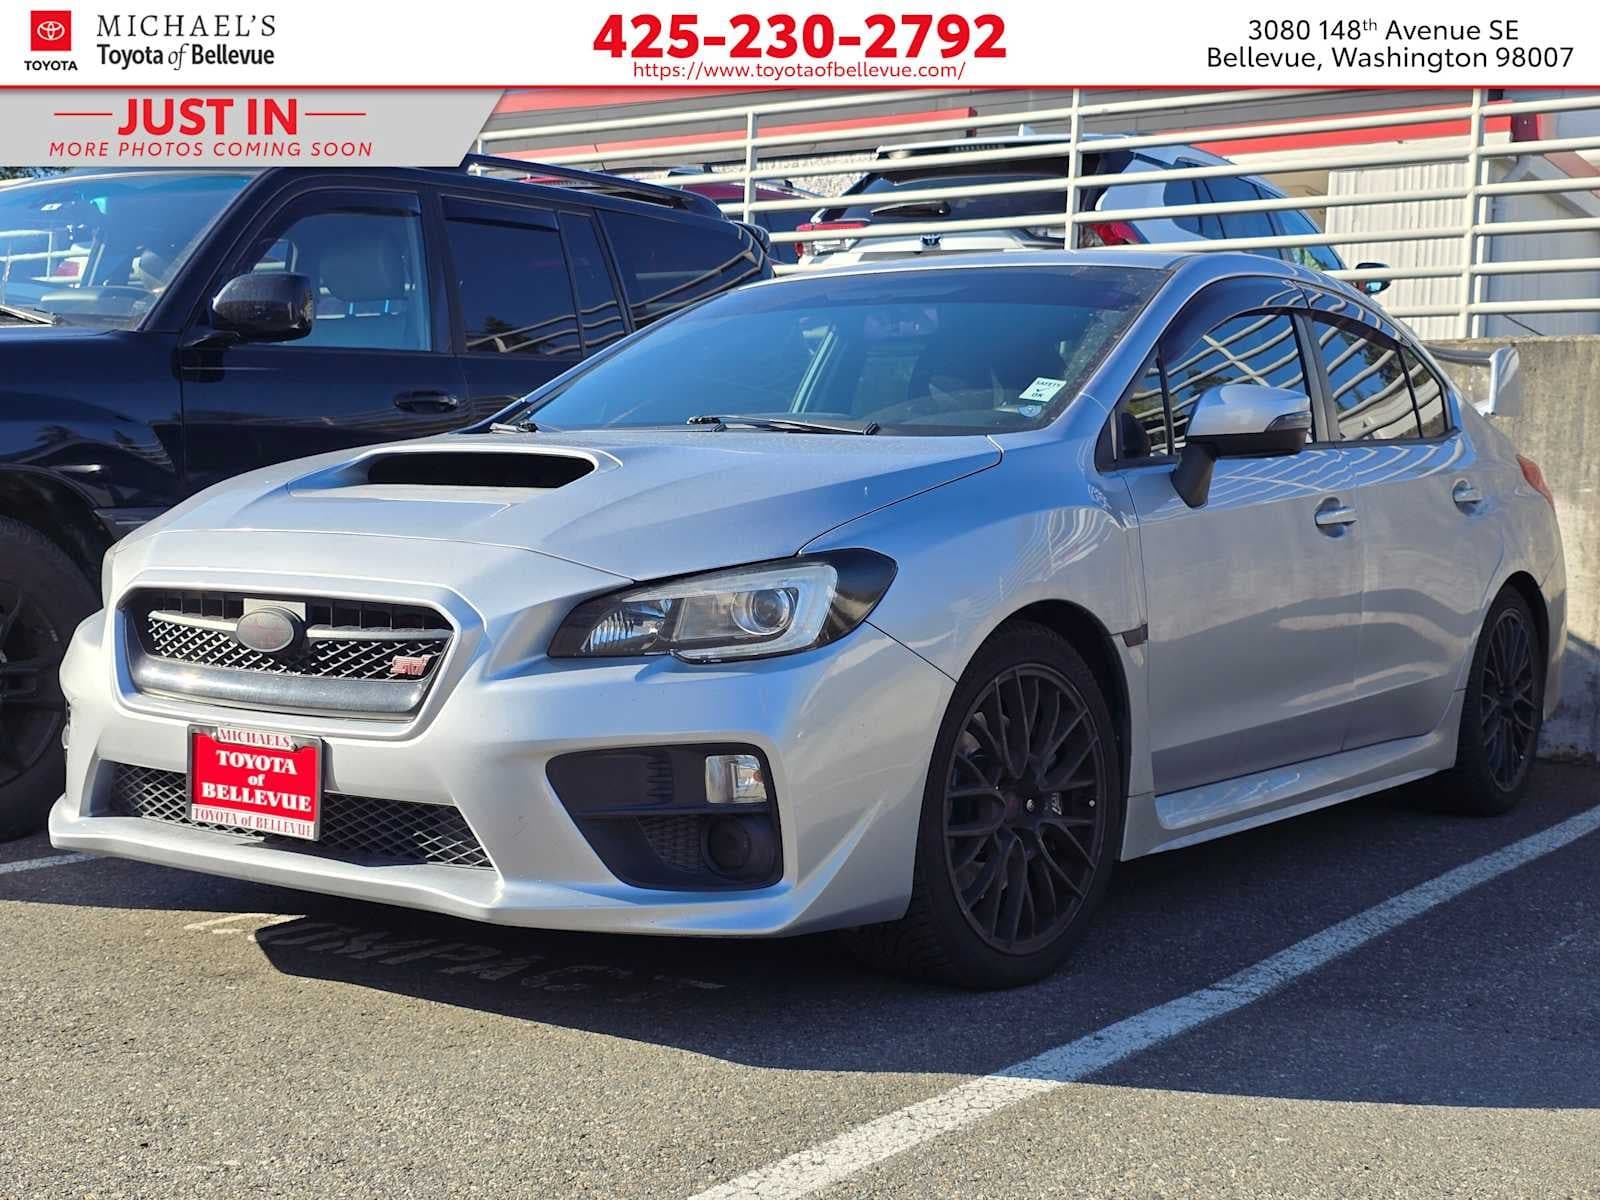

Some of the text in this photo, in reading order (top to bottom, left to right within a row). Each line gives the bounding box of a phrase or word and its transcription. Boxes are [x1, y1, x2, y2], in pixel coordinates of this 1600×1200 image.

[216, 750, 298, 775] TOYOTA
[247, 774, 266, 787] of
[201, 782, 312, 812] BELLEVUE
[194, 808, 238, 825] TOYOTA
[256, 819, 313, 838] BELLEVUE
